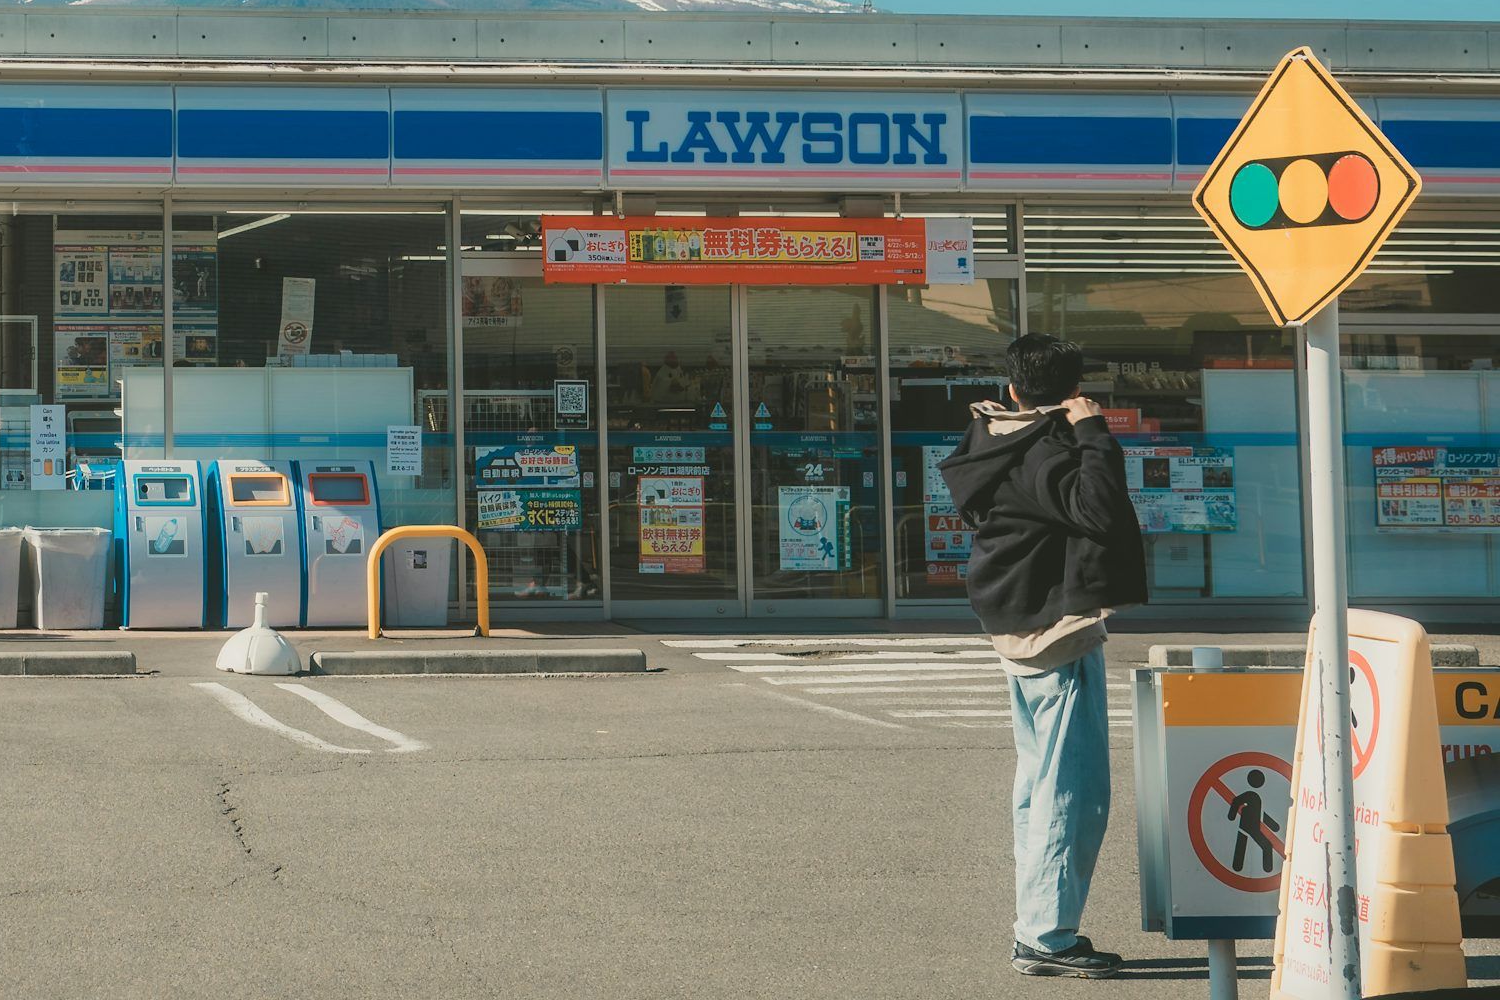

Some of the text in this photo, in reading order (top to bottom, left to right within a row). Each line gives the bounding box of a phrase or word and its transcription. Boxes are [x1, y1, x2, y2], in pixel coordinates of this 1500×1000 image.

[626, 110, 947, 165] LAWSON
[587, 240, 625, 253] おにぎり
[1107, 361, 1162, 376] 無印良品
[520, 456, 575, 466] お好きな時間に
[1448, 453, 1496, 463] ローソンアプリ
[482, 468, 520, 478] 自動車税
[527, 466, 559, 474] お支払い!
[805, 463, 823, 476] 24
[671, 487, 701, 496] おにぎり
[1380, 485, 1438, 497] 無料引換券
[480, 493, 501, 504] バイク
[527, 509, 555, 525] すぐに
[643, 527, 701, 540] 飲料無料券
[651, 541, 693, 553] もらえる!
[1455, 681, 1500, 720] C
[1302, 787, 1315, 810] No
